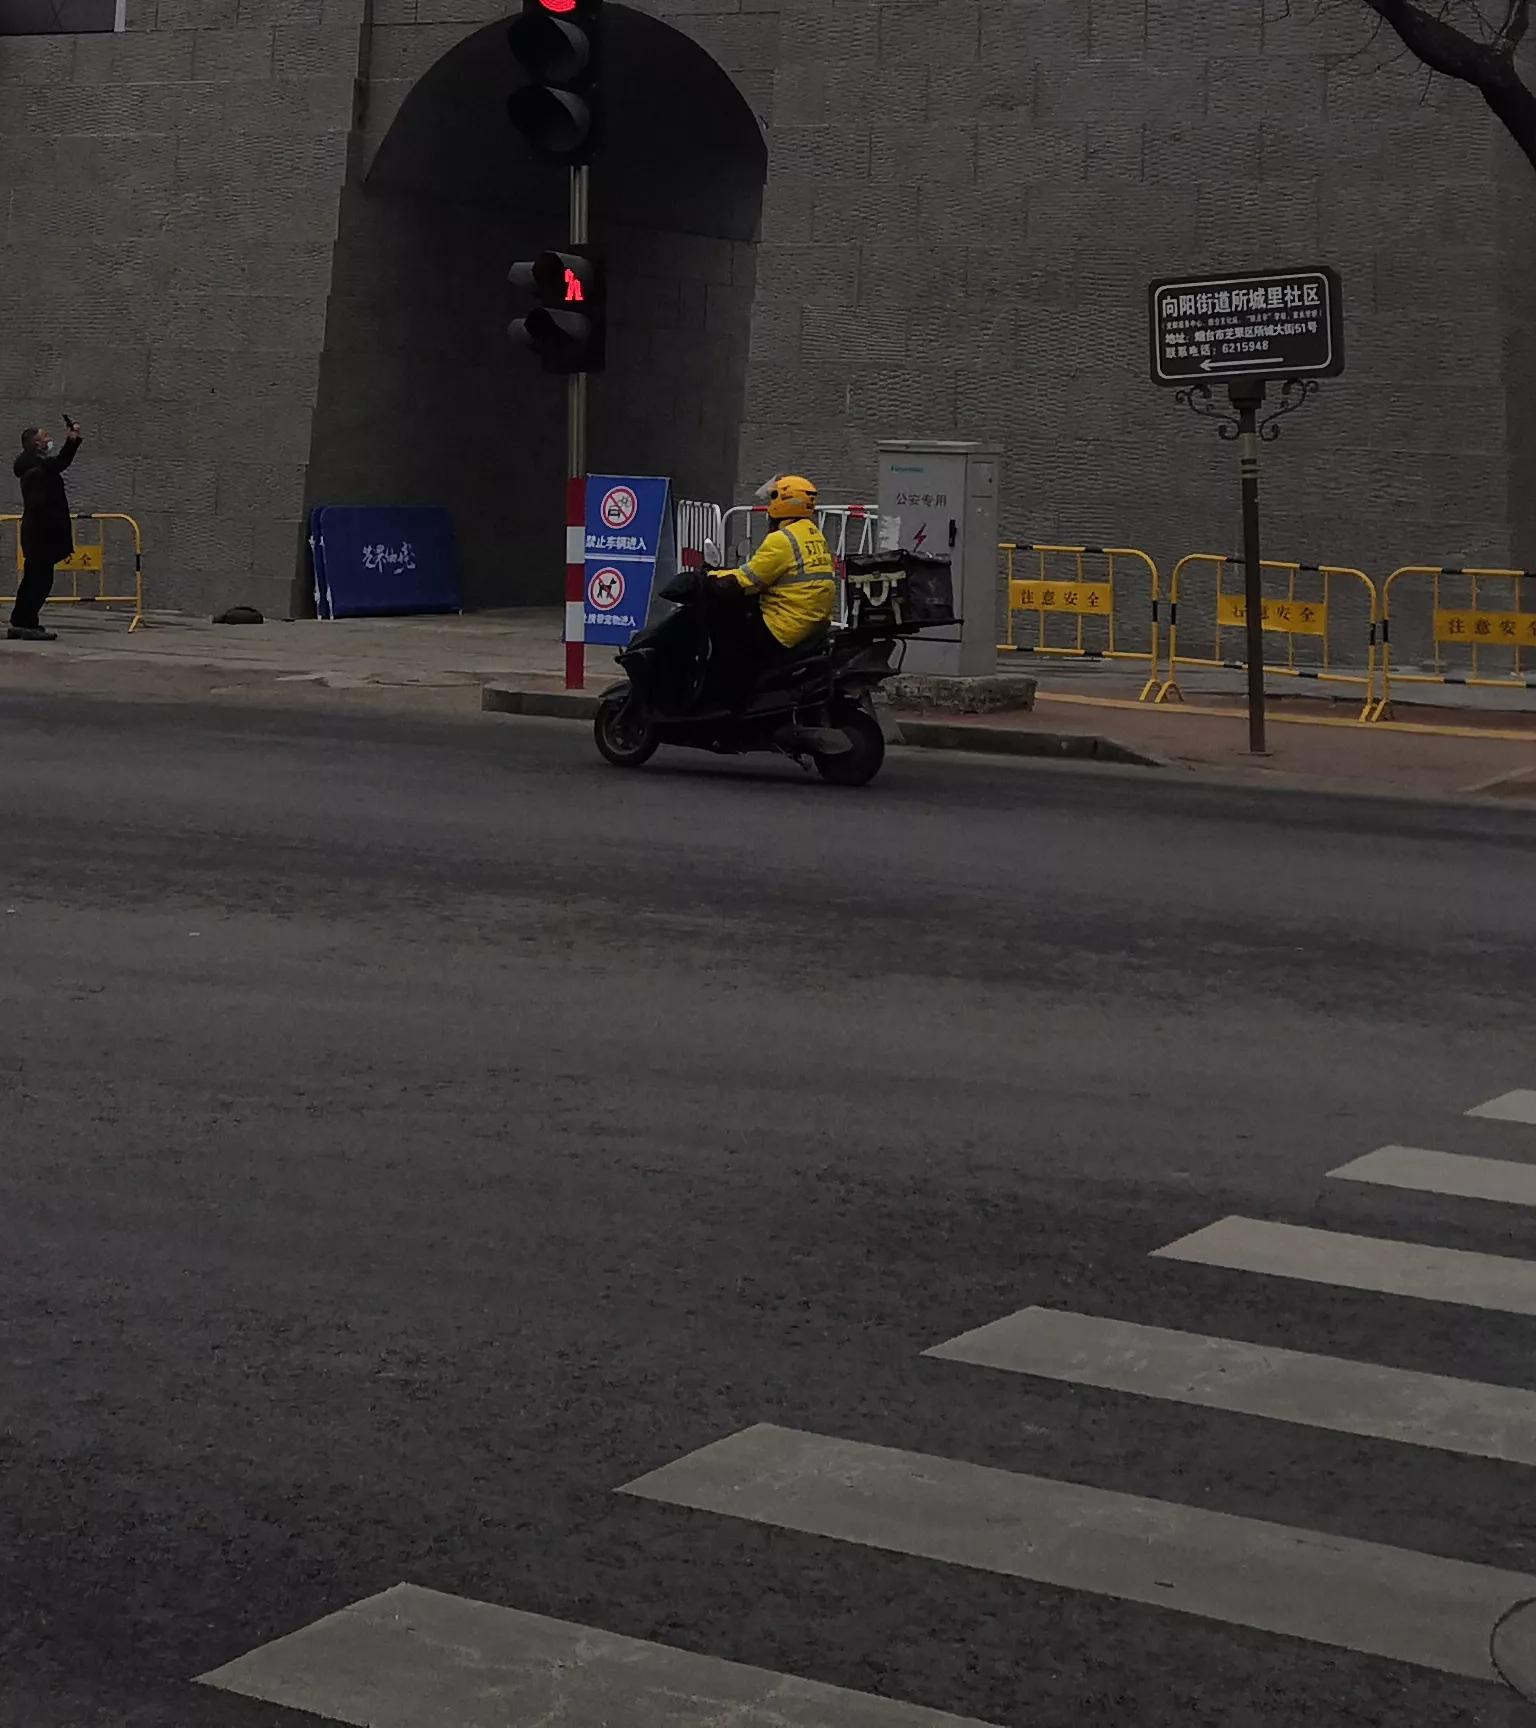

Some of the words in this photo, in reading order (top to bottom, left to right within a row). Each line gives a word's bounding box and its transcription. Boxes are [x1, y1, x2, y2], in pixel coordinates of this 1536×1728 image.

[1162, 283, 1321, 318] 向阳街道所城里社区
[896, 493, 947, 507] 公安专用
[585, 535, 647, 550] 禁止车辆进入
[1021, 589, 1100, 607] 注意安全
